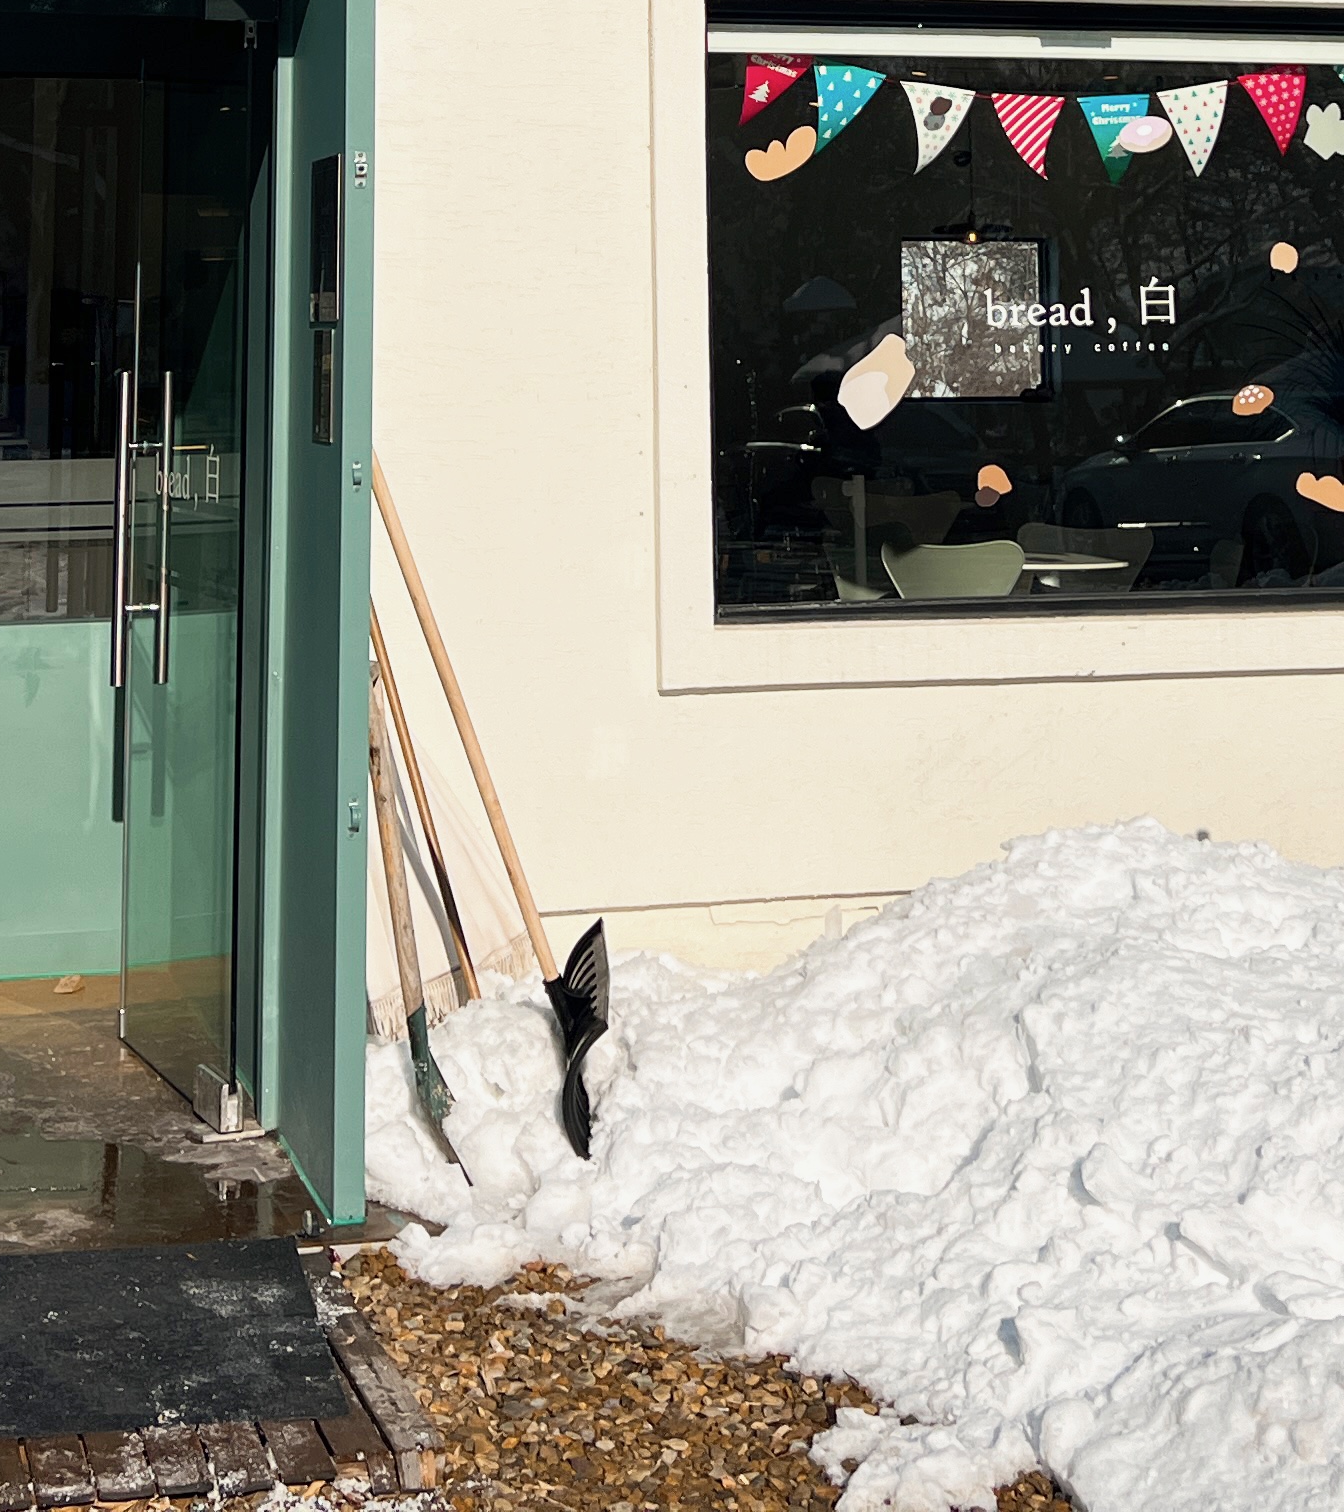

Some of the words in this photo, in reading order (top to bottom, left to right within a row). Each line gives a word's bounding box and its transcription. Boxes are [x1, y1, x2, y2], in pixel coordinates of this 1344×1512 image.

[1101, 103, 1130, 113] Merry
[984, 287, 1094, 329] bread
[1140, 276, 1176, 326] 白
[994, 342, 1073, 355] bakery
[1094, 341, 1170, 353] coffee
[156, 451, 191, 501] bead
[205, 444, 220, 503] 白
